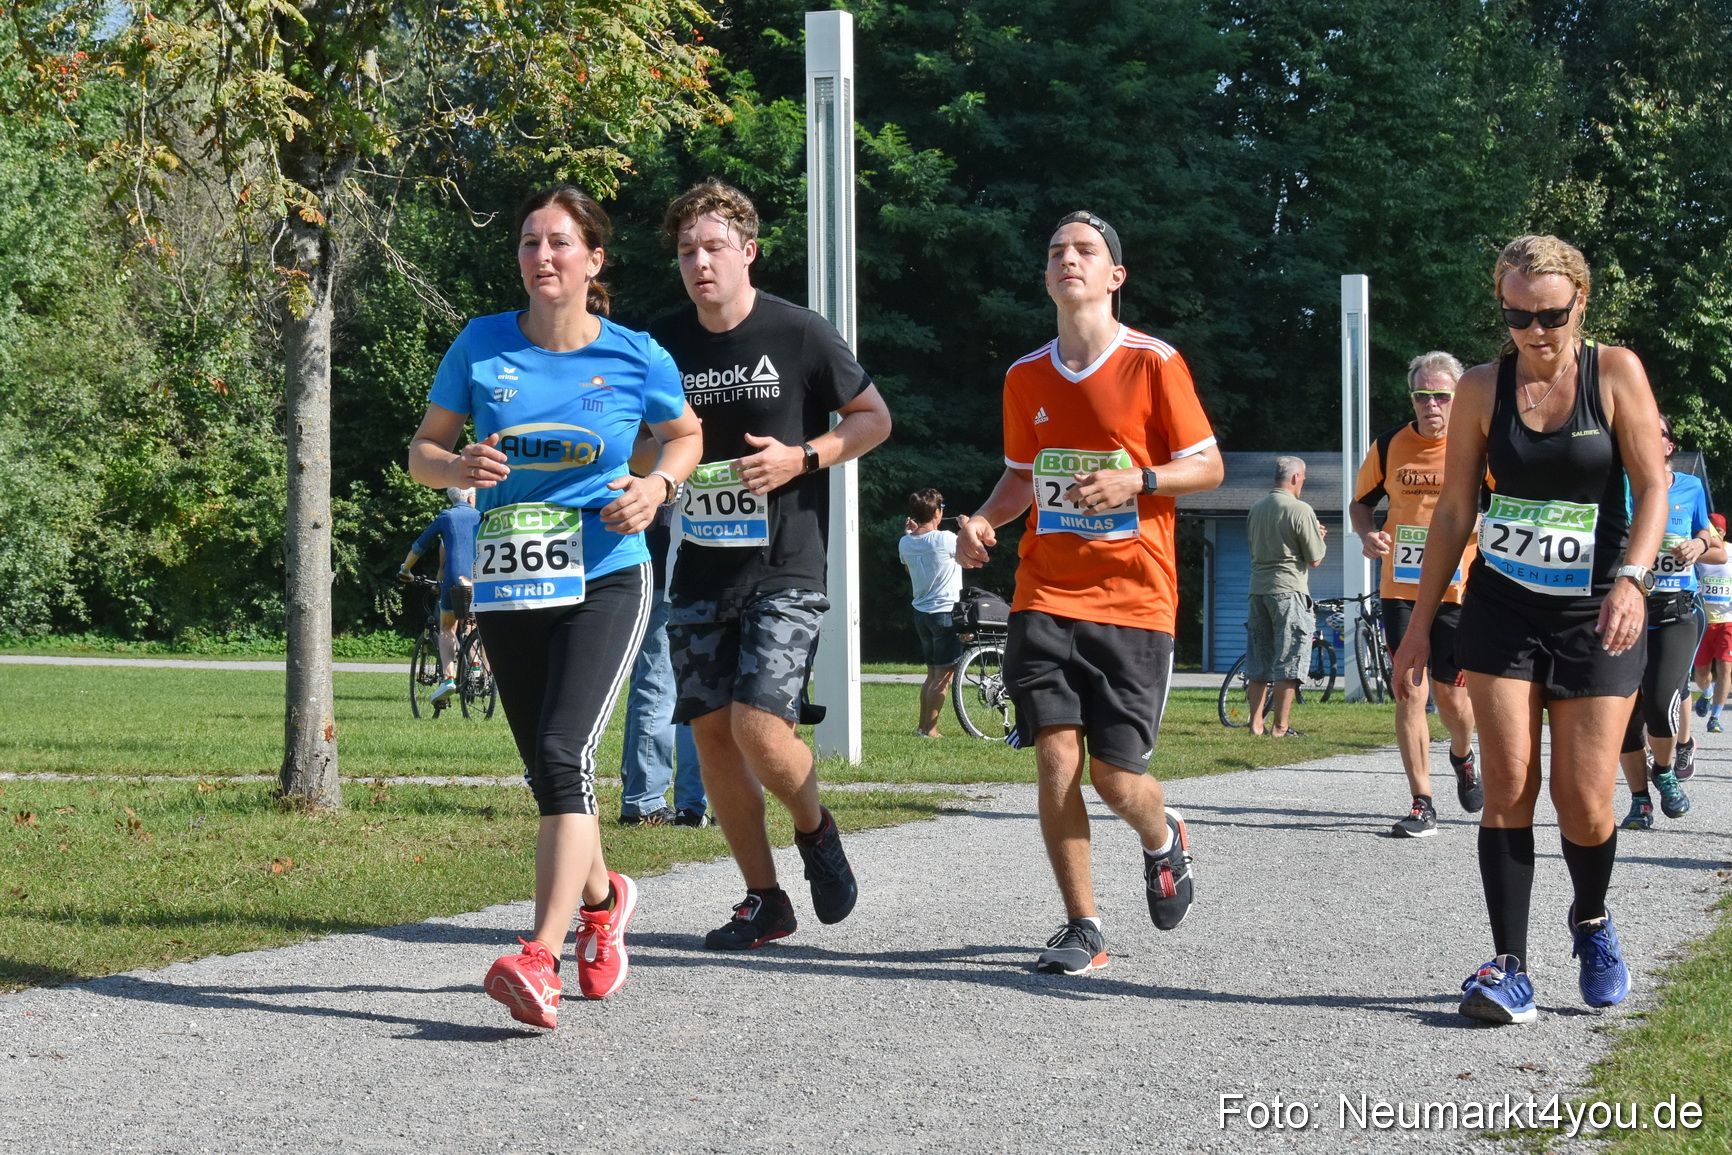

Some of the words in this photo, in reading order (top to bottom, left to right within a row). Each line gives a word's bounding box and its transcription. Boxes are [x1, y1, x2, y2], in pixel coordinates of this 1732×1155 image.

[685, 386, 780, 406] IGHTLIFTING
[488, 433, 602, 465] AUF10!
[1041, 453, 1123, 473] BOCK
[1402, 475, 1440, 486] OEXL
[684, 489, 756, 516] 2106
[484, 507, 570, 536] BOCK
[1060, 516, 1114, 530] NIKLAS
[1500, 502, 1585, 528] BOCK
[691, 524, 748, 536] NICOLAI
[1400, 529, 1428, 542] BO
[1490, 524, 1580, 563] 2710
[482, 540, 570, 575] 2366
[1502, 561, 1574, 583] DENISA
[494, 583, 555, 599] ASTRID
[1705, 585, 1730, 595] 2813
